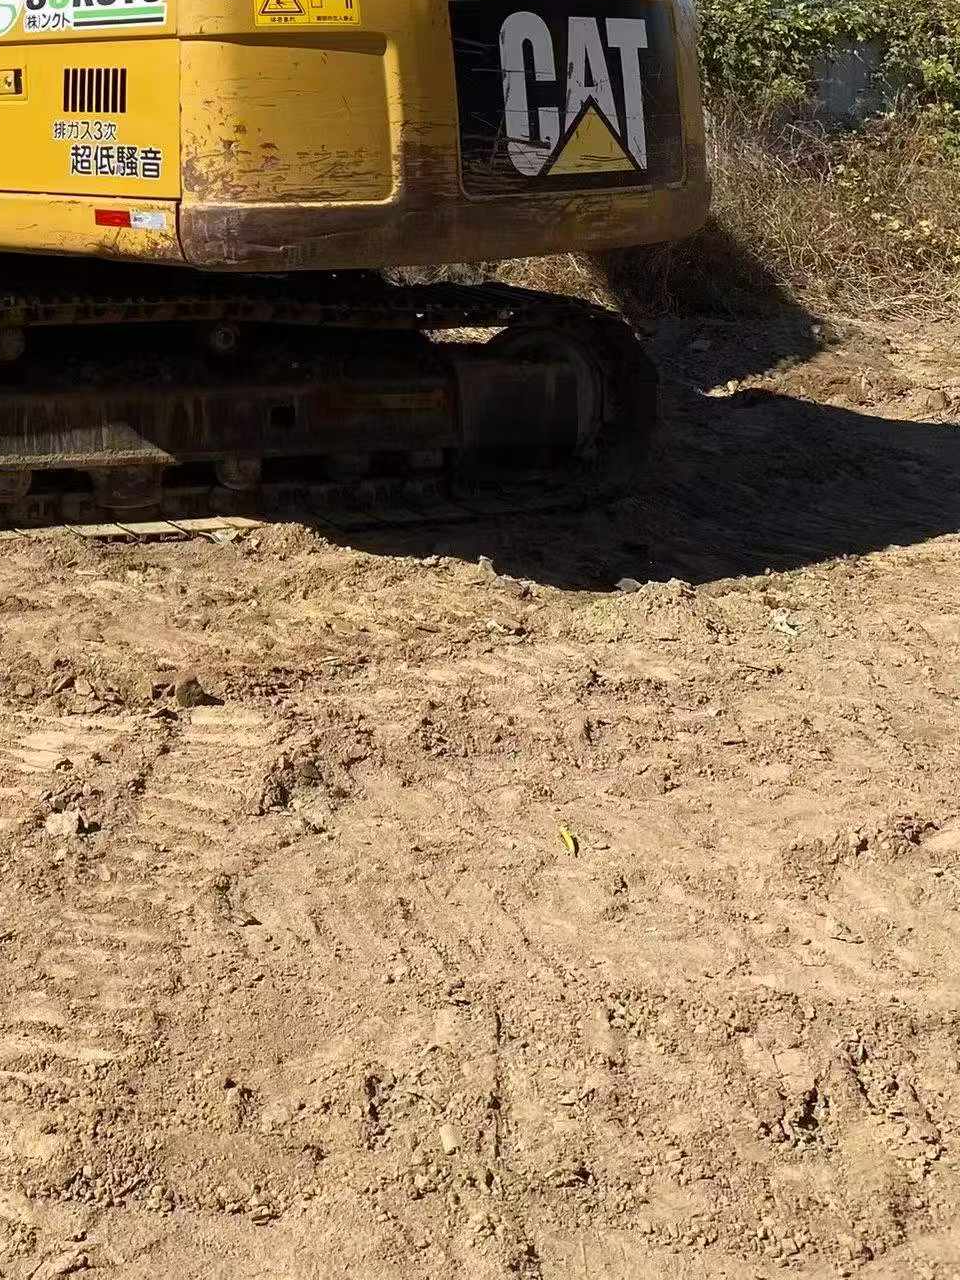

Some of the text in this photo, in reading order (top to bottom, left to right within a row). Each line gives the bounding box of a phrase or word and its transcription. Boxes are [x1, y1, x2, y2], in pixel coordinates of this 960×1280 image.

[499, 11, 648, 176] CAT
[54, 121, 117, 140] 排ガス3次
[71, 145, 162, 179] 超低騒音
